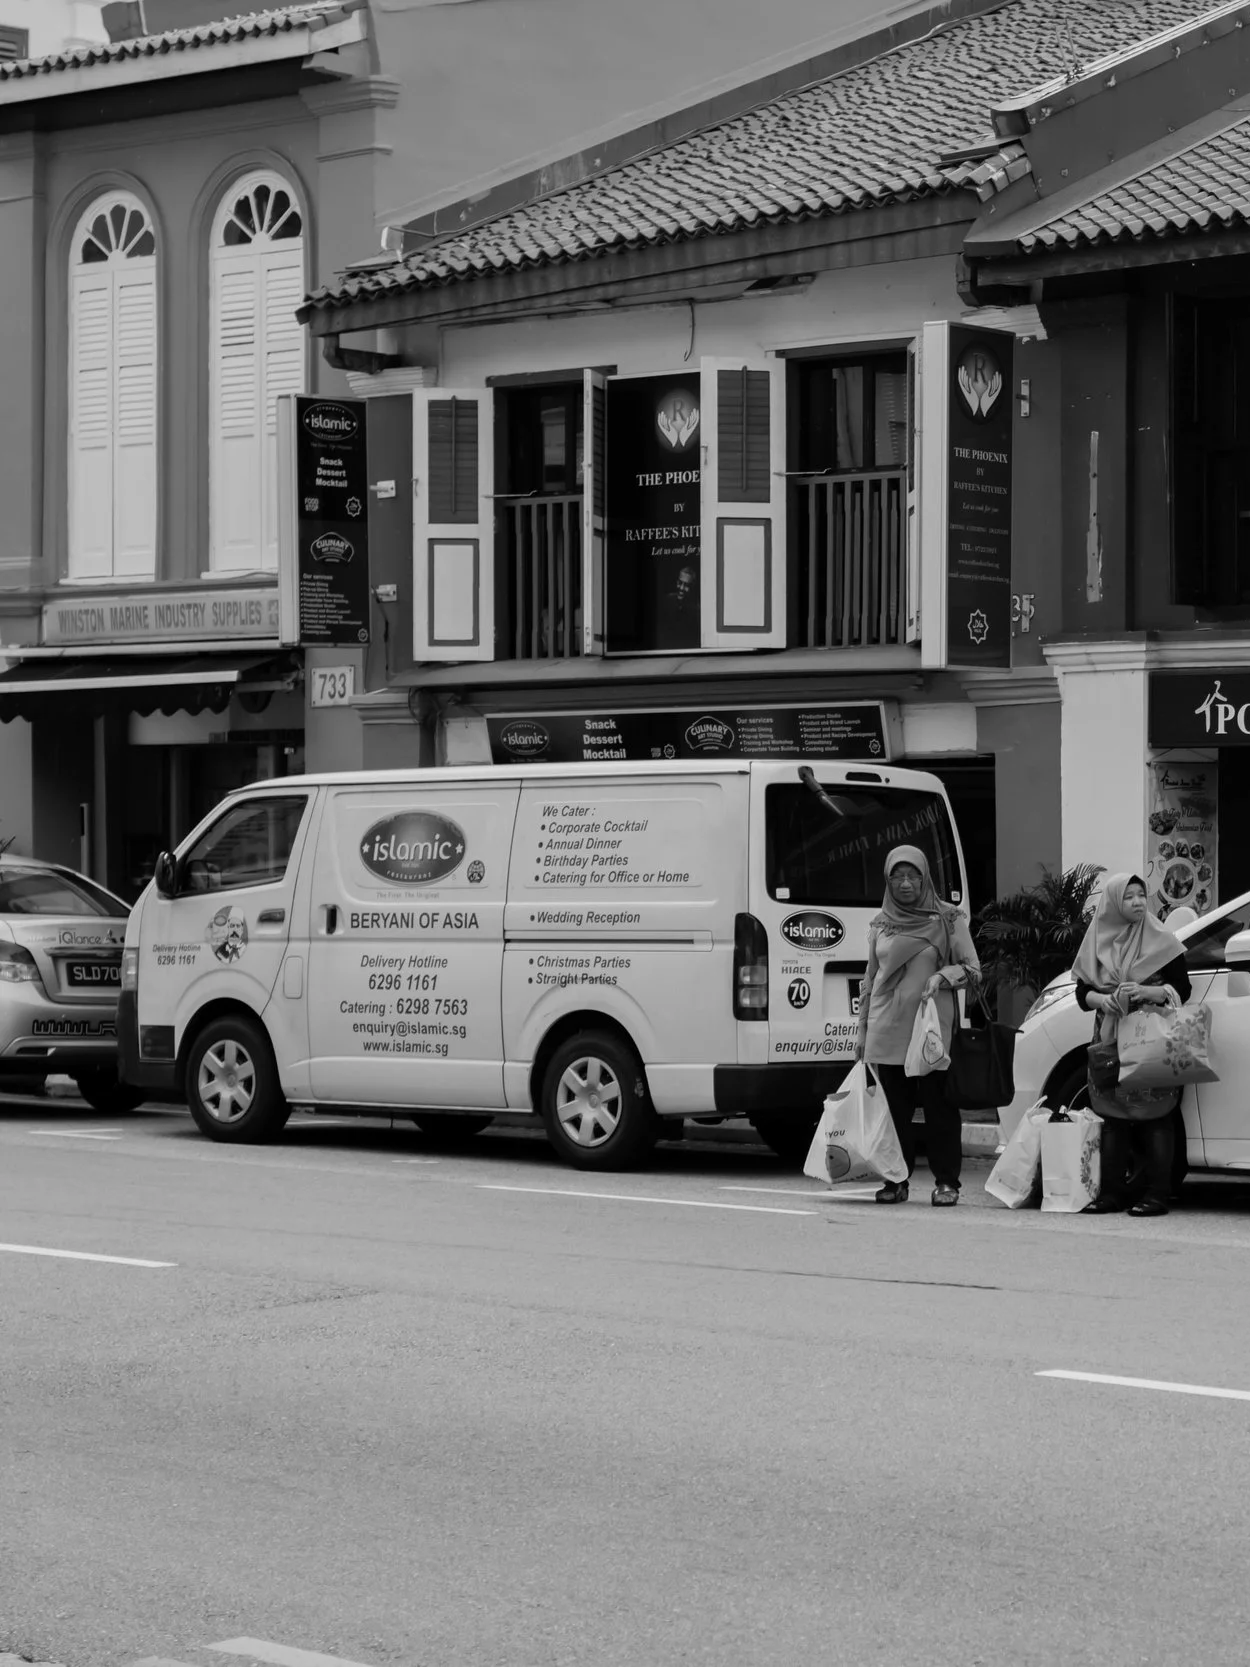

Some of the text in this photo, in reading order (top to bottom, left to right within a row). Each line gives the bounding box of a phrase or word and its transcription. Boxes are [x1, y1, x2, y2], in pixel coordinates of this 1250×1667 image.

[311, 414, 351, 431] islamic
[320, 457, 343, 466] Snack
[953, 446, 1008, 464] THE PHOENIX
[317, 467, 346, 477] Dessert
[976, 467, 985, 476] BY
[316, 478, 348, 488] Mocktail
[636, 473, 663, 486] THE
[673, 503, 686, 513] BY
[625, 527, 679, 542] RAFFEE'S
[651, 546, 662, 556] Let
[58, 608, 104, 633] WINSTON
[110, 606, 149, 631] MARINE
[154, 602, 206, 628] INDUSTRY
[212, 600, 262, 627] SUPPLIES
[318, 672, 347, 700] 733
[584, 719, 616, 729] Snack
[690, 724, 728, 736] CULINARY
[507, 731, 544, 746] islamic
[583, 734, 623, 745] Dessert
[583, 749, 626, 759] Mocktail
[542, 805, 589, 817] We Cater
[548, 820, 648, 836] Corporate Cocktail
[373, 833, 452, 861] islamic
[545, 838, 622, 850] Annual Dinner
[544, 854, 628, 869] Birthday Parties
[386, 870, 432, 880] restaurant
[542, 870, 690, 886] Catering for Office or Home
[350, 912, 479, 929] BERYANI OF ASIA
[537, 911, 640, 926] Wedding Reception
[789, 922, 836, 938] islamic
[153, 944, 178, 953] Delivery
[157, 955, 196, 965] 6296 1161
[360, 955, 448, 971] Delivery Hotline
[537, 956, 631, 968] Christmas Parties
[73, 966, 122, 980] SLD70
[781, 966, 812, 974] HIACE
[368, 973, 438, 991] 6296 1161
[536, 973, 617, 988] Straight Parties
[790, 982, 809, 1001] 70
[339, 998, 468, 1017] Catering 6298 7563
[353, 1021, 467, 1039] enquiry@islamic.sg
[363, 1040, 449, 1057] www.islamic.sg
[828, 1129, 846, 1138] YOU
